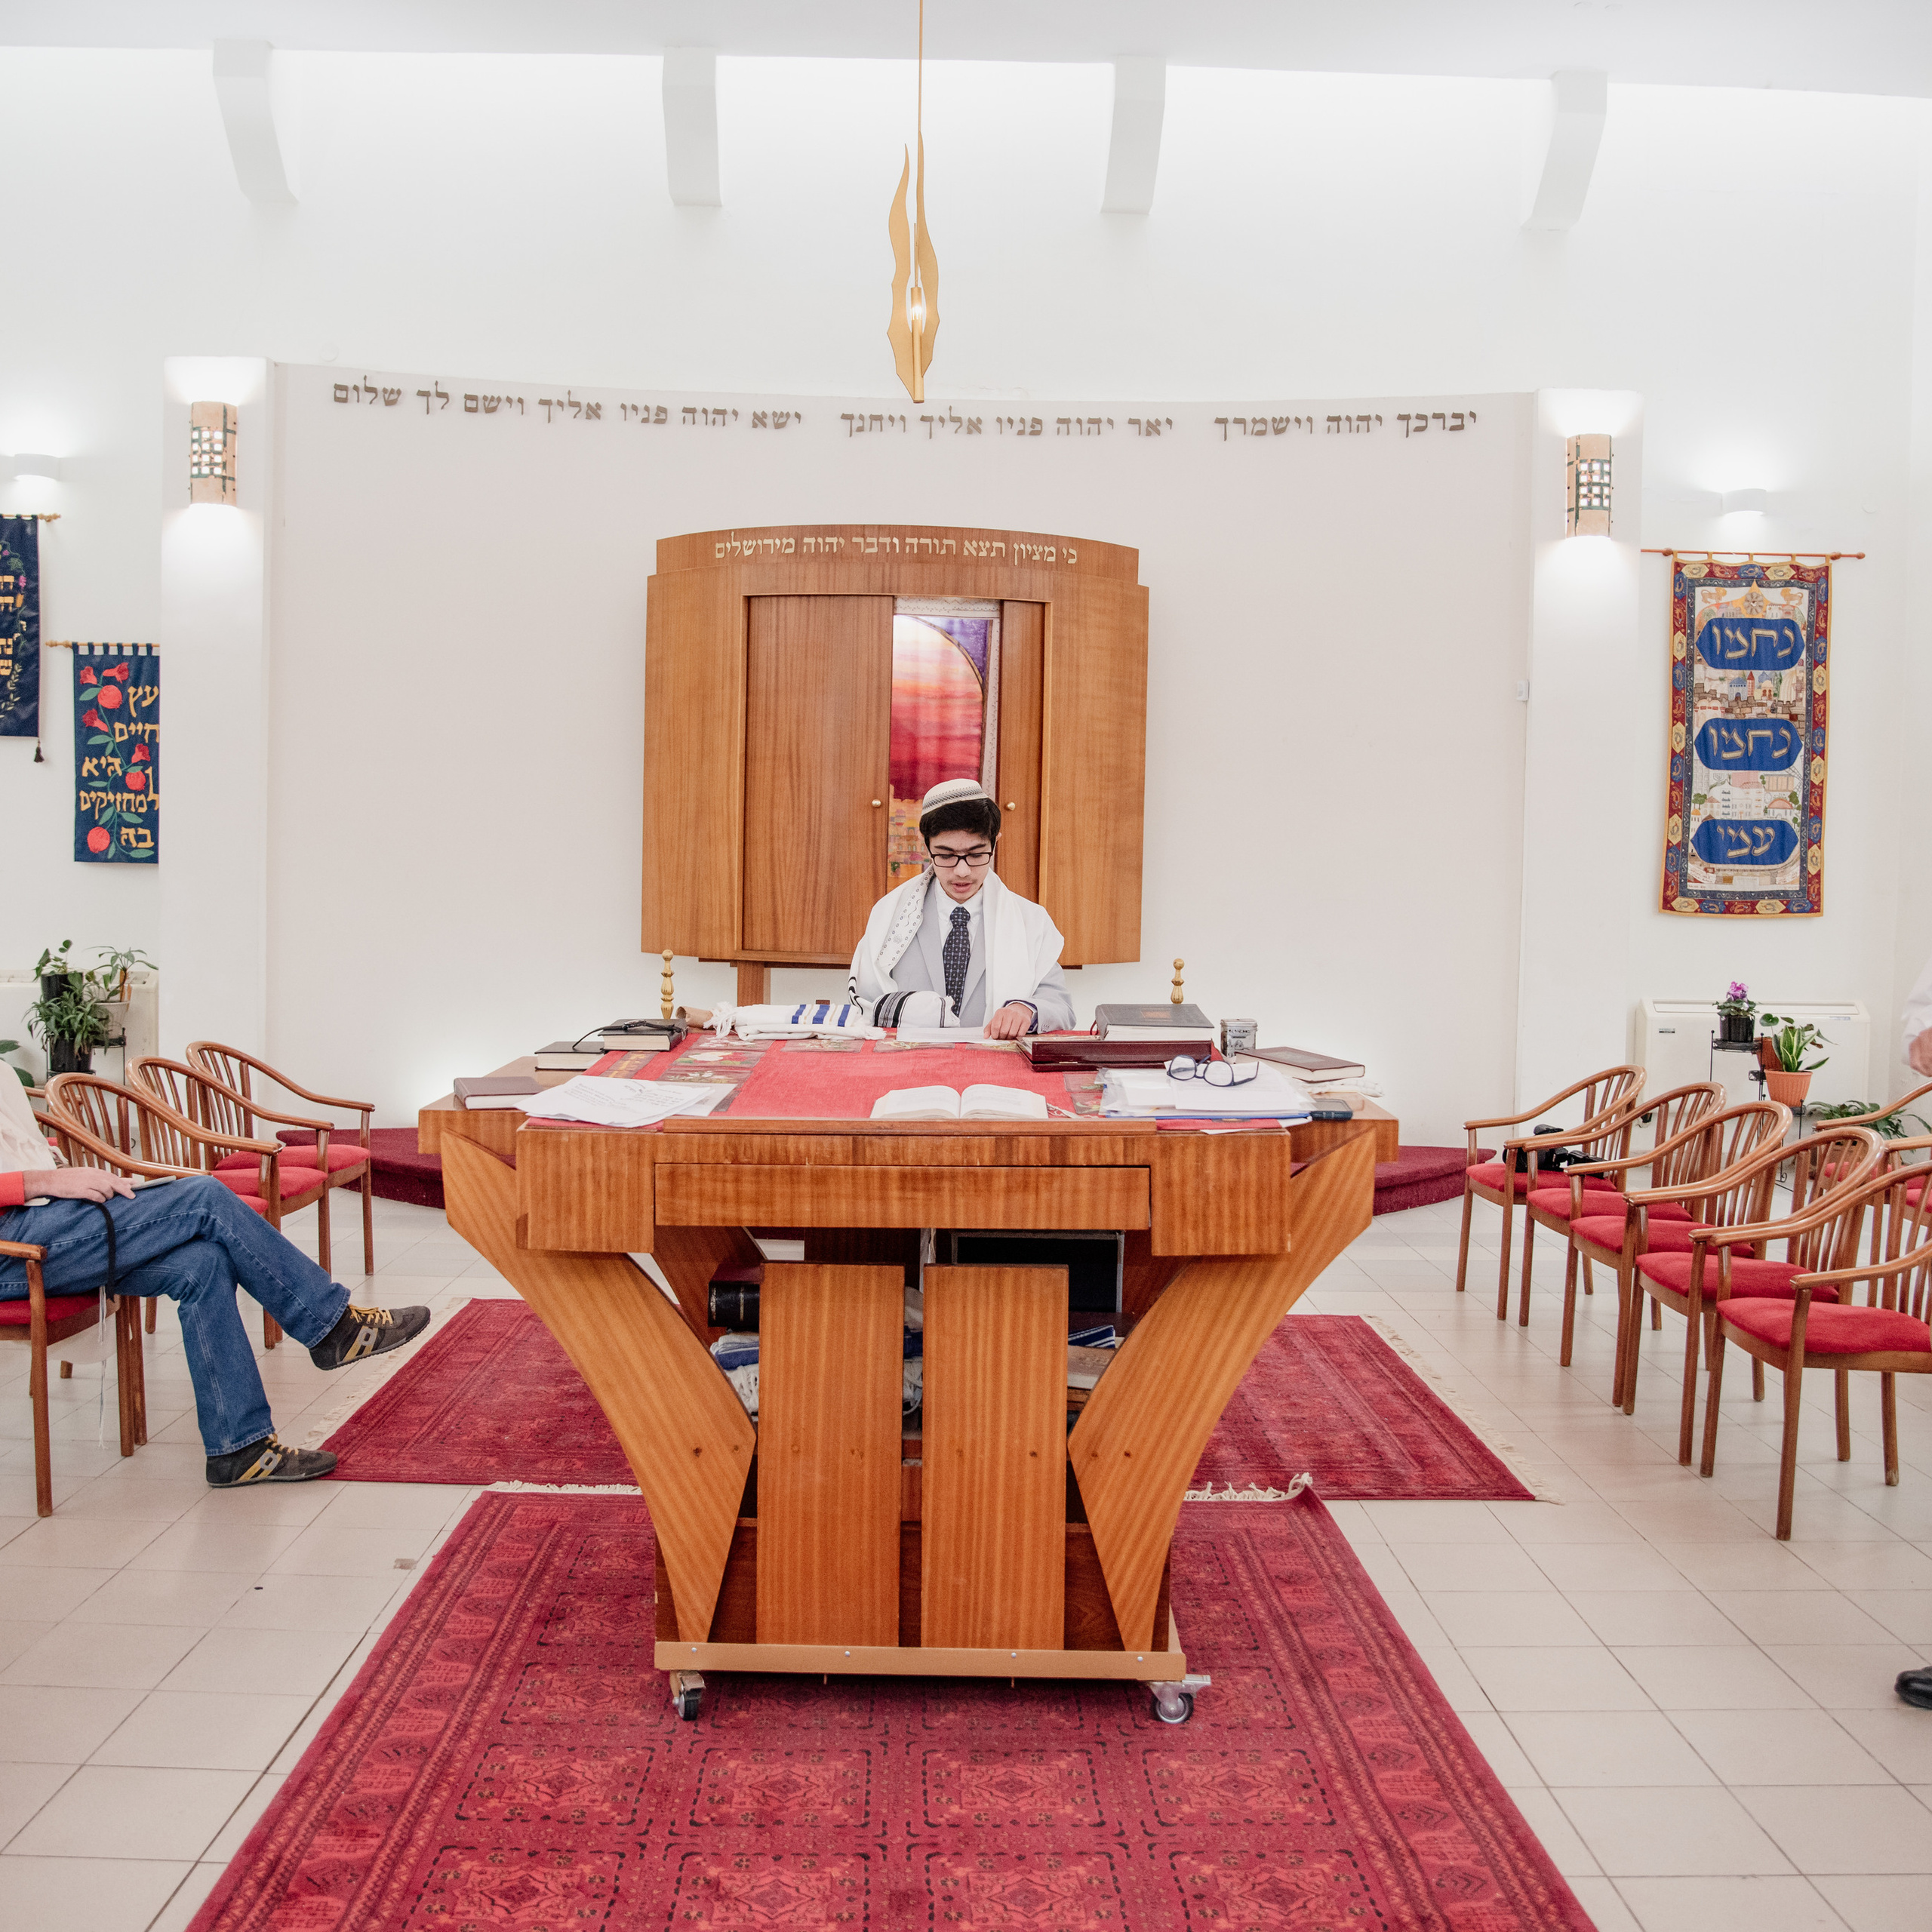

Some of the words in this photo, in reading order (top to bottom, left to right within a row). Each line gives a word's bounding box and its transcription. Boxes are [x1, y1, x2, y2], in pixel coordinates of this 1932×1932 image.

[334, 375, 401, 406] שלום
[417, 380, 449, 414] לך
[464, 394, 524, 415] וישם
[538, 390, 601, 423] אליך
[620, 403, 667, 424] פניו
[682, 407, 738, 426] יהוה
[752, 411, 801, 429] ישא
[841, 413, 907, 437] ויחנך
[920, 405, 983, 439] אליך
[996, 417, 1042, 435] פניו
[1057, 417, 1113, 435] יהוה
[1128, 417, 1172, 436] יאר
[1327, 414, 1382, 434] יהוה
[1397, 411, 1476, 438] יברכך
[1214, 416, 1312, 441] וישמרך
[715, 532, 795, 558] מירושלים
[804, 537, 844, 553] יהוה
[852, 537, 899, 553] ודבר
[906, 537, 955, 554] תורה
[964, 541, 1005, 557] תצא
[1013, 543, 1056, 565] מציון
[1062, 548, 1078, 564] כי
[1711, 625, 1795, 660] נחמו
[128, 685, 159, 717] עץ
[113, 721, 159, 743] חיים
[1709, 726, 1792, 760] נחמו
[82, 755, 122, 777] היא
[79, 766, 159, 820] למחזיקים
[121, 827, 154, 848] בה
[1718, 826, 1776, 858] עמי
